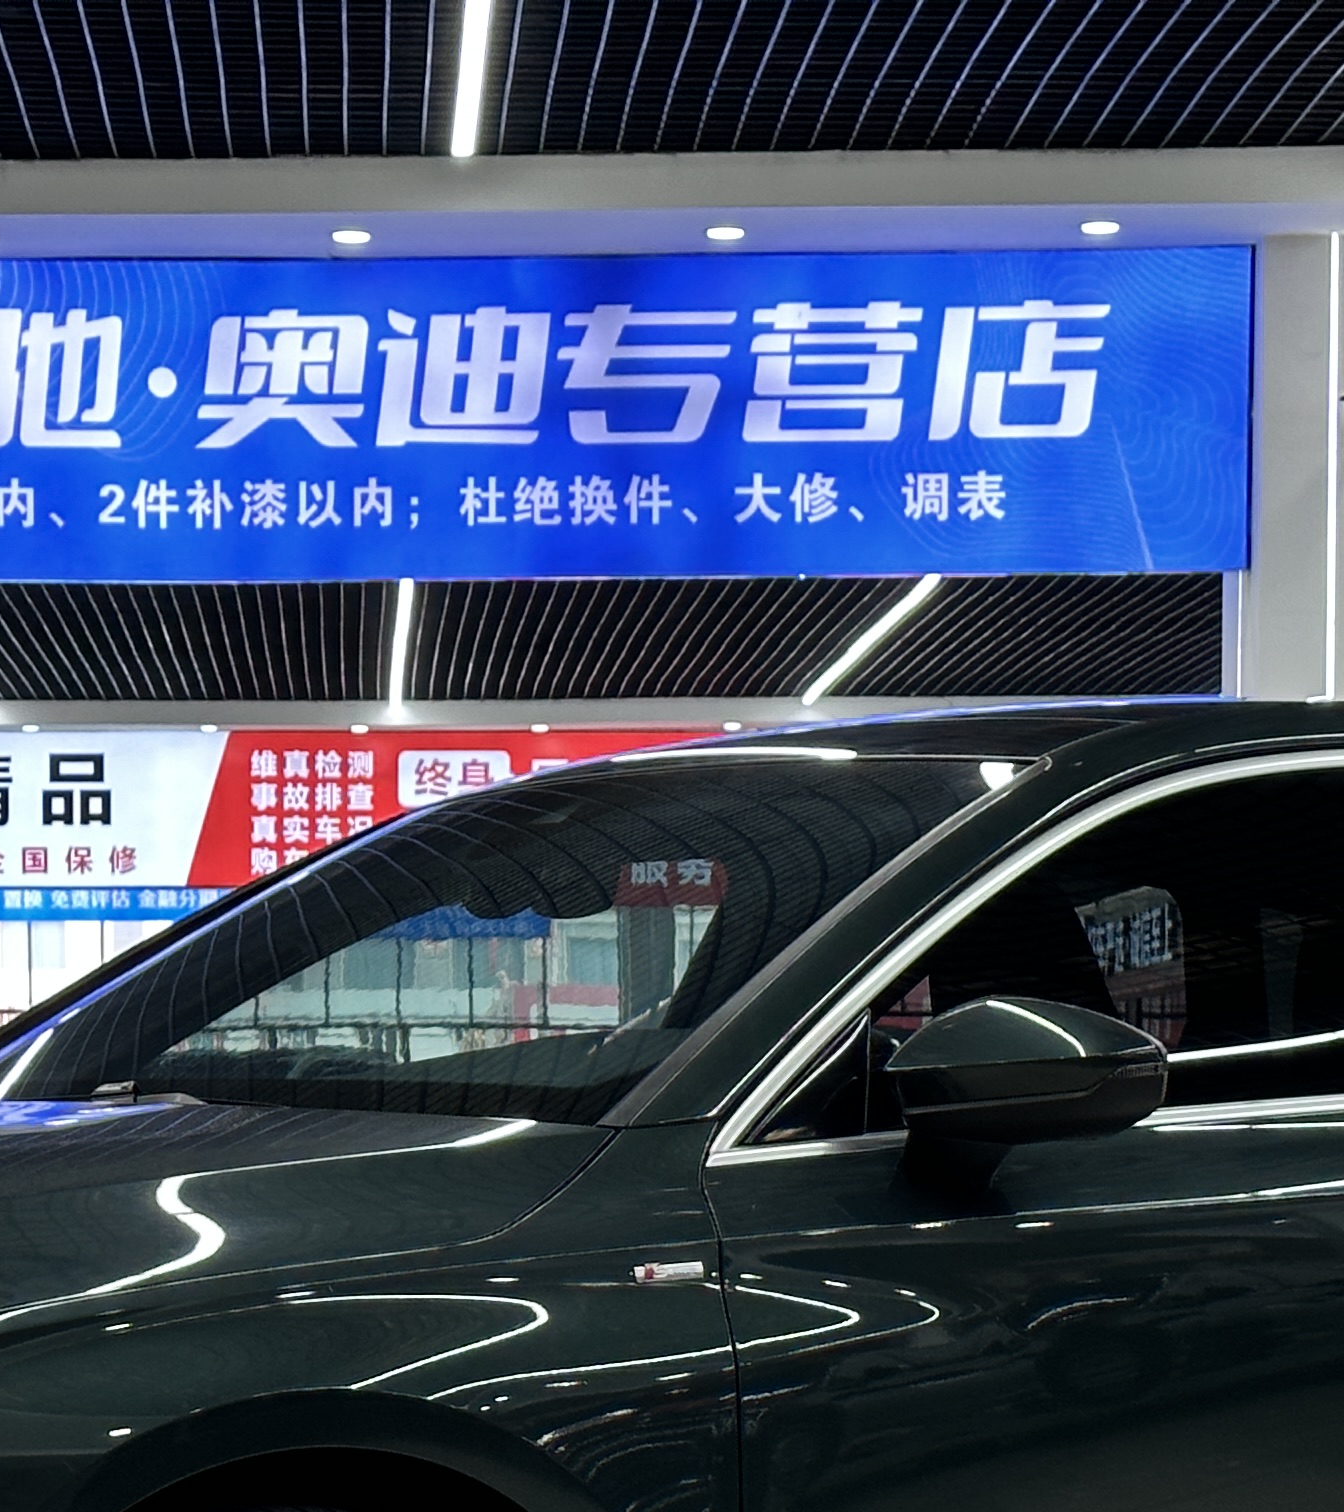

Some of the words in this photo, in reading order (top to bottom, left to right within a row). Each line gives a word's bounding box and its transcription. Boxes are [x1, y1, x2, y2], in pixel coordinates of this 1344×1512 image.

[250, 749, 375, 779] 维真检测
[250, 782, 375, 812] 事故排查
